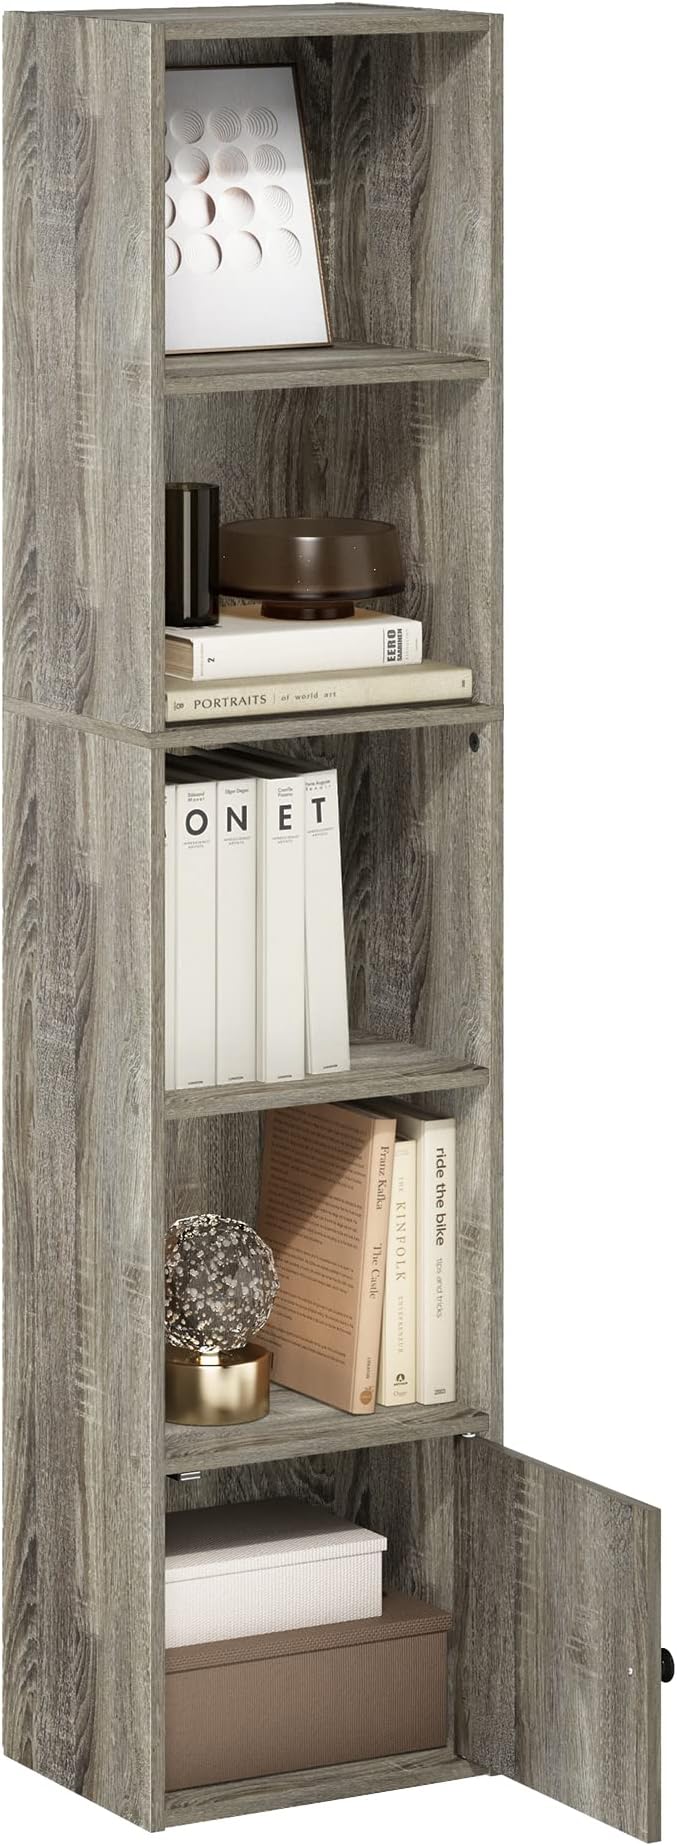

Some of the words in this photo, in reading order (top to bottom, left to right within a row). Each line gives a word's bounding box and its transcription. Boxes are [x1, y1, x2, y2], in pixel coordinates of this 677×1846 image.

[387, 629, 396, 662] EERO
[194, 694, 267, 709] PORTRAITS
[281, 693, 290, 701] of
[295, 691, 319, 701] world
[323, 691, 336, 699] art
[186, 809, 208, 836] O
[227, 805, 247, 832] N
[279, 804, 292, 830] E
[311, 797, 326, 823] T
[378, 1146, 389, 1176] Franz
[436, 1147, 447, 1178] ride
[375, 1179, 387, 1210] Kafka
[436, 1182, 447, 1208] the
[396, 1202, 406, 1280] KINFOLK
[436, 1213, 447, 1246] bike
[372, 1242, 383, 1266] The
[435, 1258, 443, 1273] tips
[369, 1268, 380, 1299] Castle
